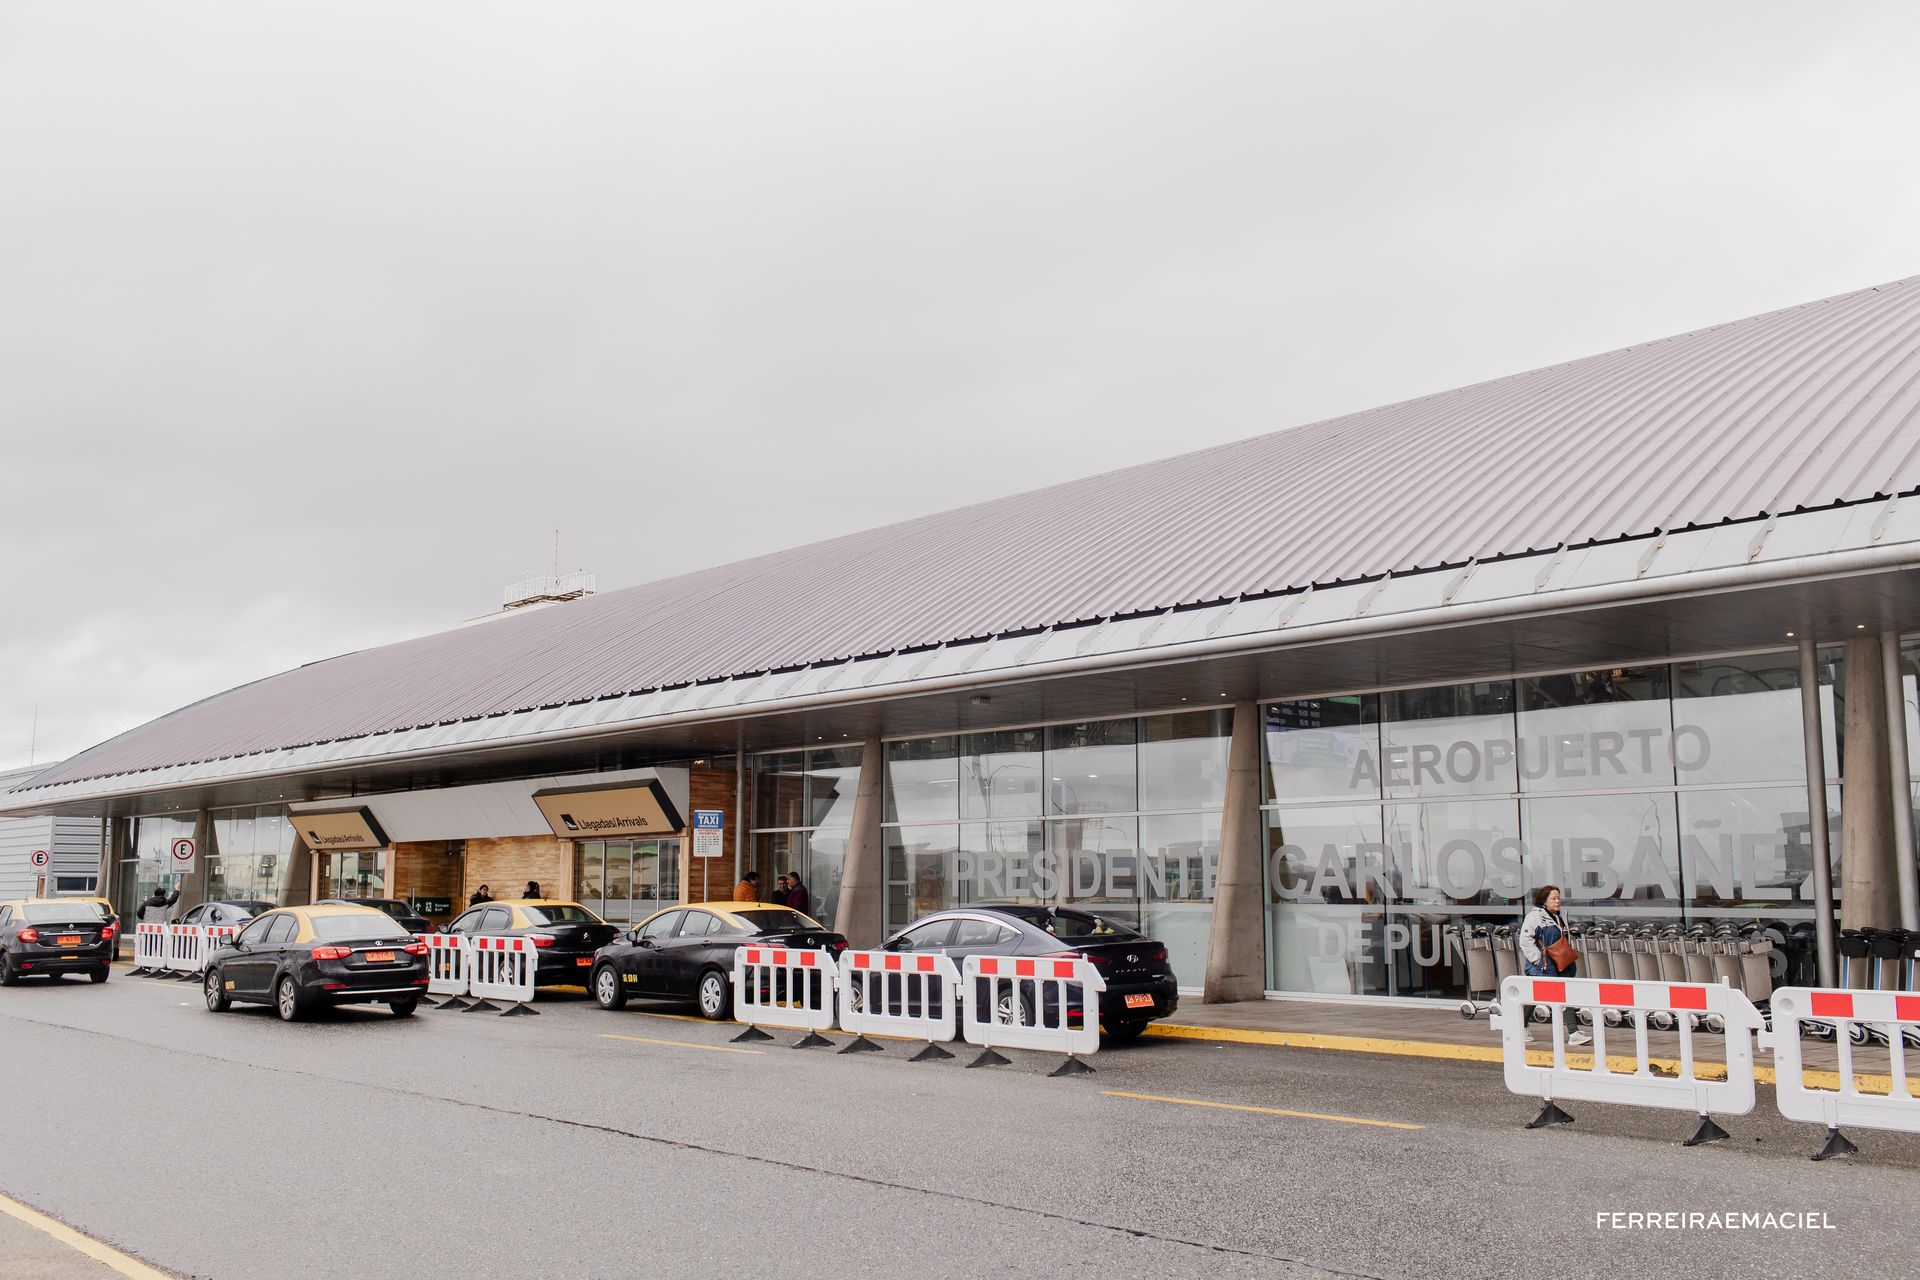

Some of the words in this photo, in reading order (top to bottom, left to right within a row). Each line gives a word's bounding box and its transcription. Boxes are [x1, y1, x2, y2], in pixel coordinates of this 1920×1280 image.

[1350, 725, 1710, 789] AEROPUERTO
[578, 816, 649, 831] Llegadas/Arrivals
[698, 816, 719, 825] TAXI
[181, 844, 187, 855] E
[36, 853, 44, 863] E
[1270, 838, 1532, 900] CARLOS
[1318, 922, 1374, 964] DE
